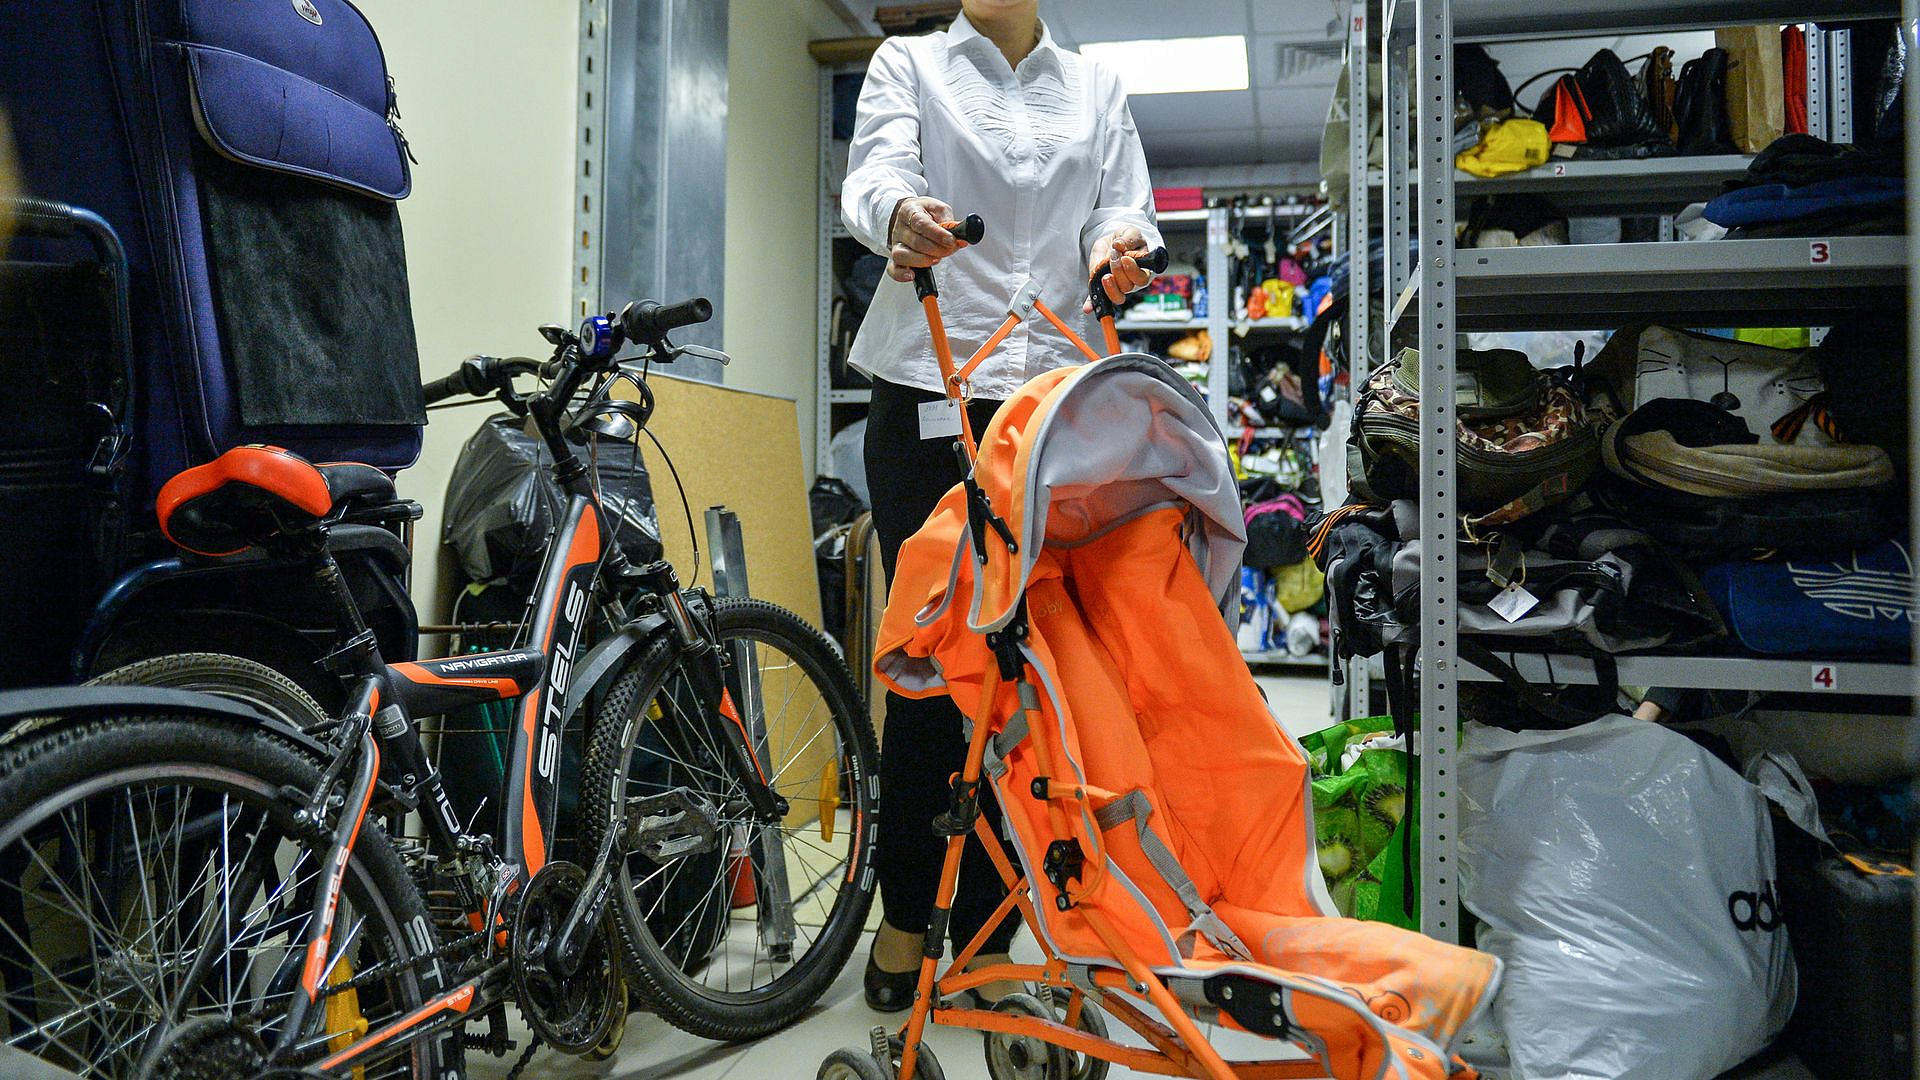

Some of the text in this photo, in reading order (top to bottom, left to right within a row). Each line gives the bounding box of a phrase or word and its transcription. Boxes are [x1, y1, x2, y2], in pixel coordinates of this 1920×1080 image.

[1556, 165, 1564, 175] 2
[1811, 243, 1829, 263] 3
[440, 653, 528, 673] NAVIGATOR
[538, 580, 585, 785] STELS
[1814, 667, 1833, 688] 4
[860, 774, 881, 893] STELS
[322, 846, 350, 928] STELS
[584, 872, 612, 925] STELS
[447, 989, 472, 1007] STELS
